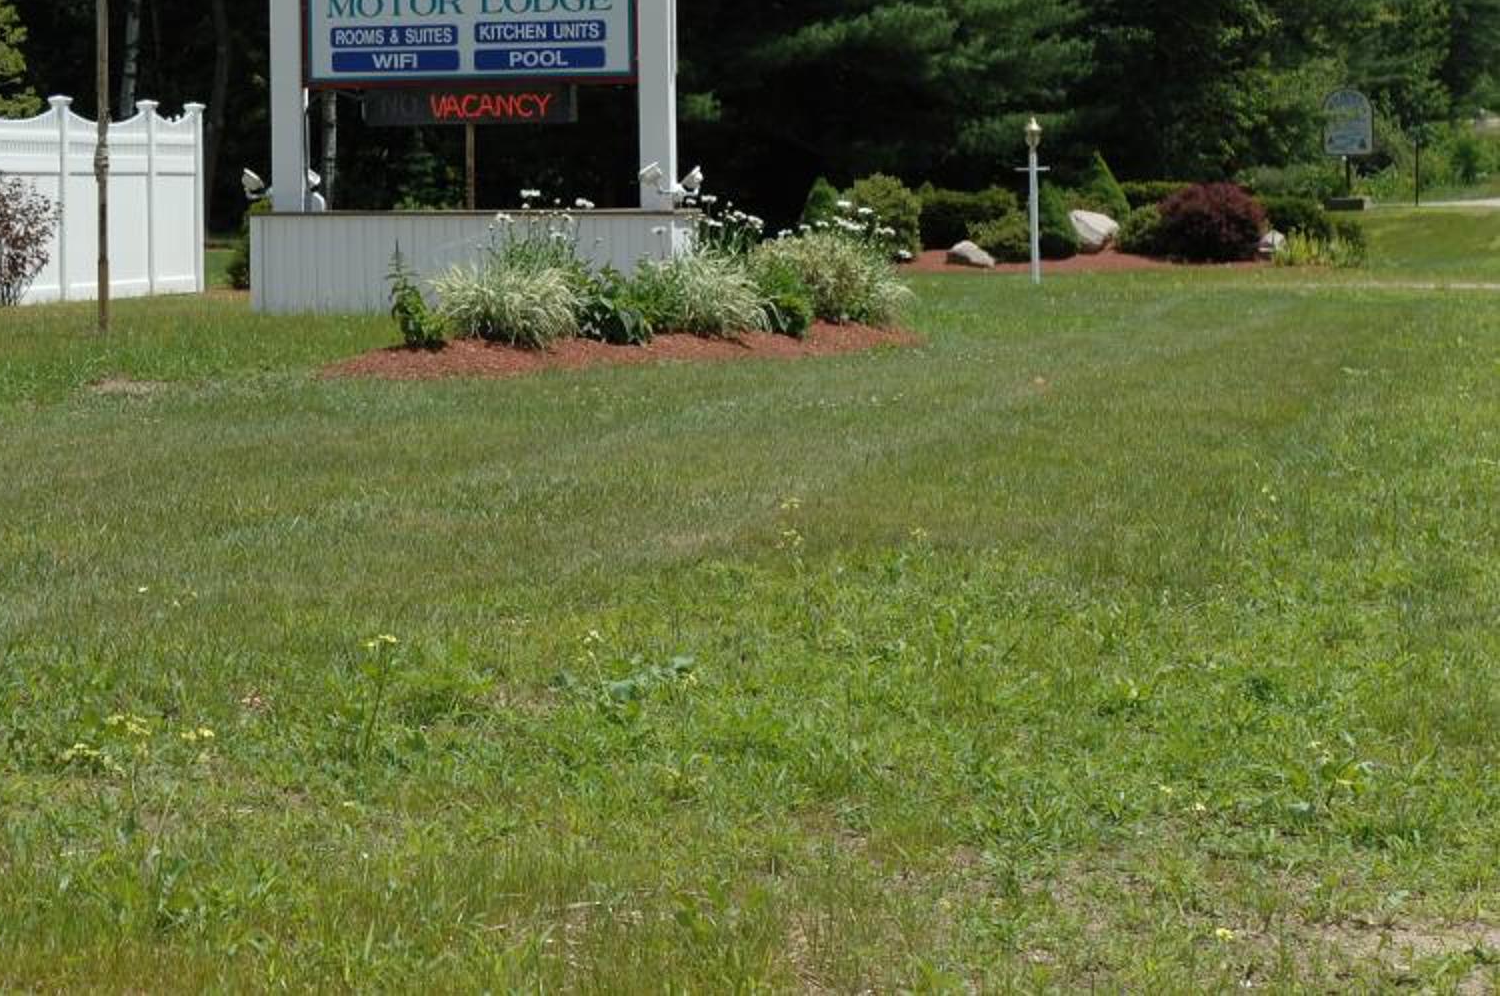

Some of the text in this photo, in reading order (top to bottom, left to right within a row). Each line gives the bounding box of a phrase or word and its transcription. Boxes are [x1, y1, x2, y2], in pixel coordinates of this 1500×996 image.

[335, 25, 453, 45] ROOMS & SUITES
[479, 22, 600, 41] KITCHEN UNITS
[372, 52, 419, 70] WIFI
[509, 51, 568, 67] POOL
[429, 93, 552, 119] VACANCY
